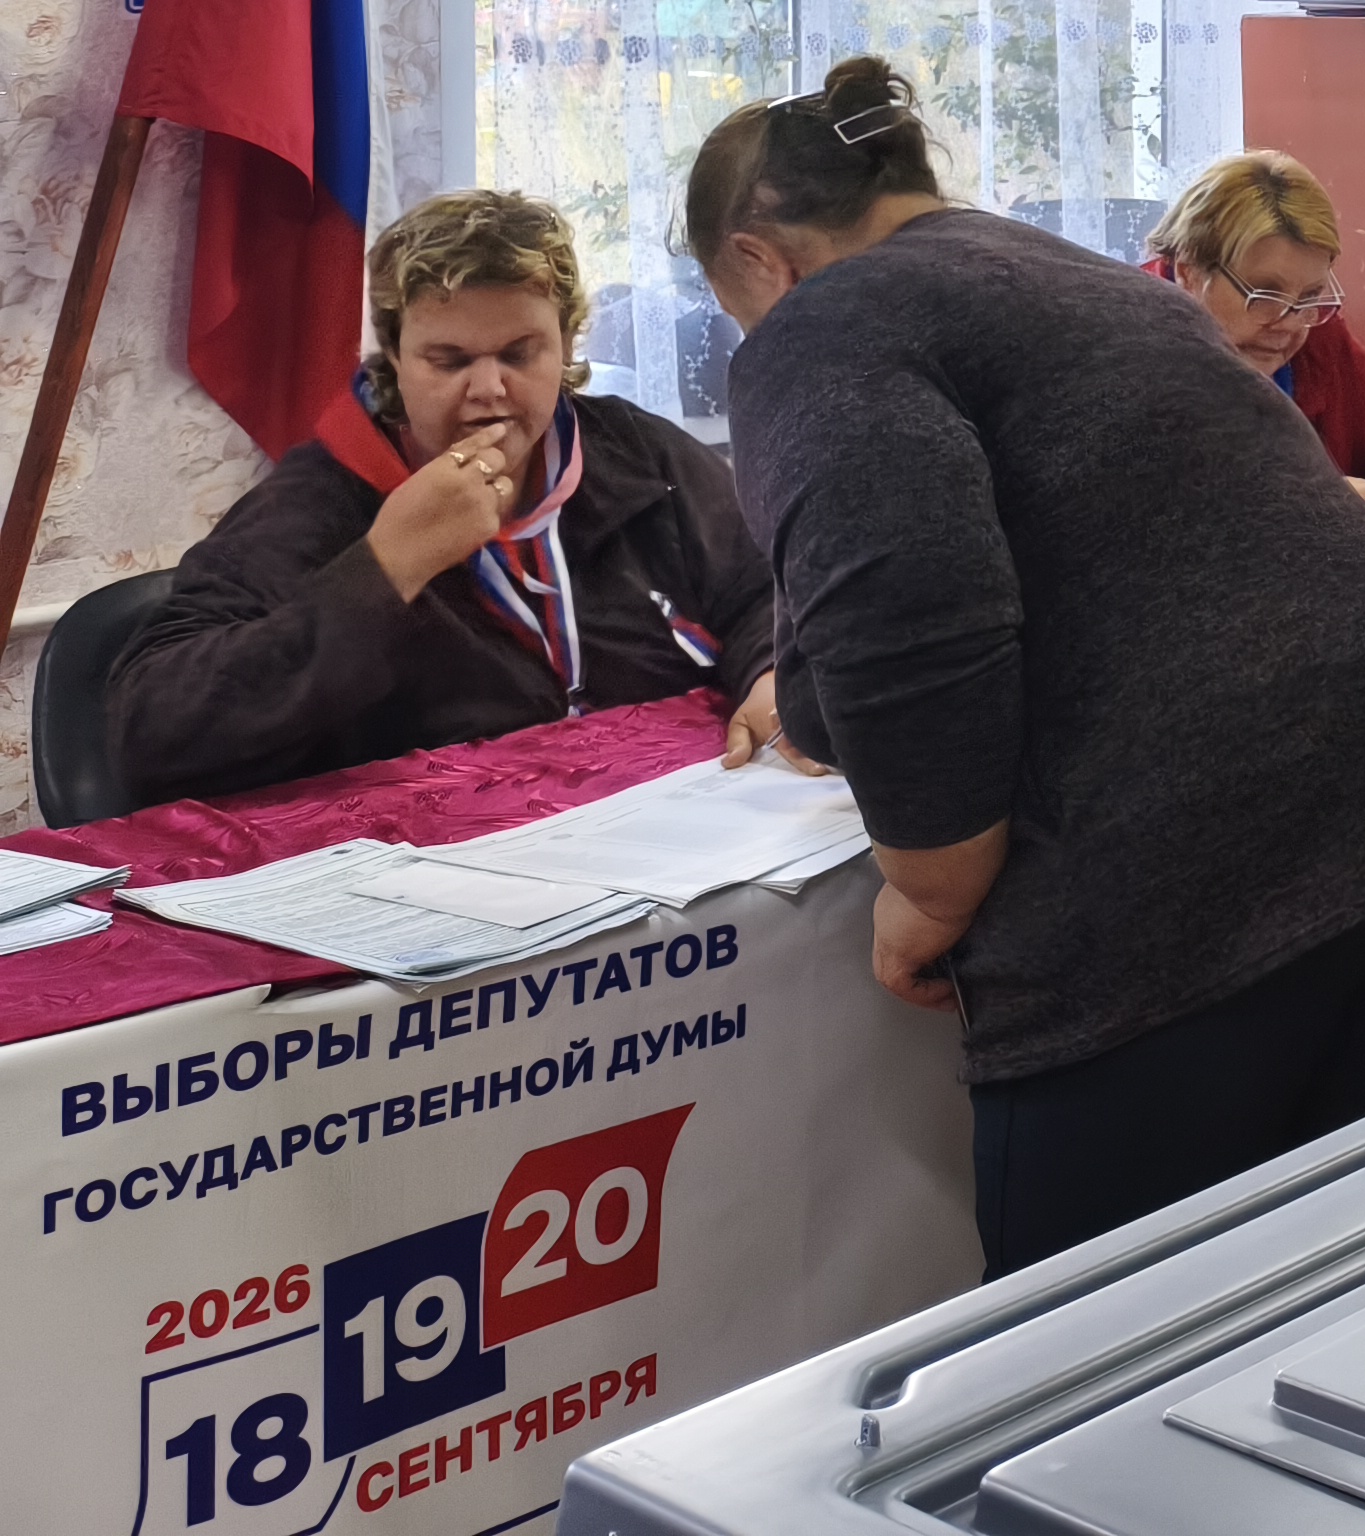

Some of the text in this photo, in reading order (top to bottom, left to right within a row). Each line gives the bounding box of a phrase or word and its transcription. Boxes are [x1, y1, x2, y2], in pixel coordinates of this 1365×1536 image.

[42, 1002, 748, 1235] ГОСУДАРСТВЕННОЙ ДУМЫ
[60, 923, 739, 1137] ВЫБОРЫ ДЕПУТАТОВ
[144, 1264, 311, 1355] 2026
[165, 1165, 649, 1527] 18 19 20
[356, 1352, 659, 1514] СЕНТЯБРЯ
